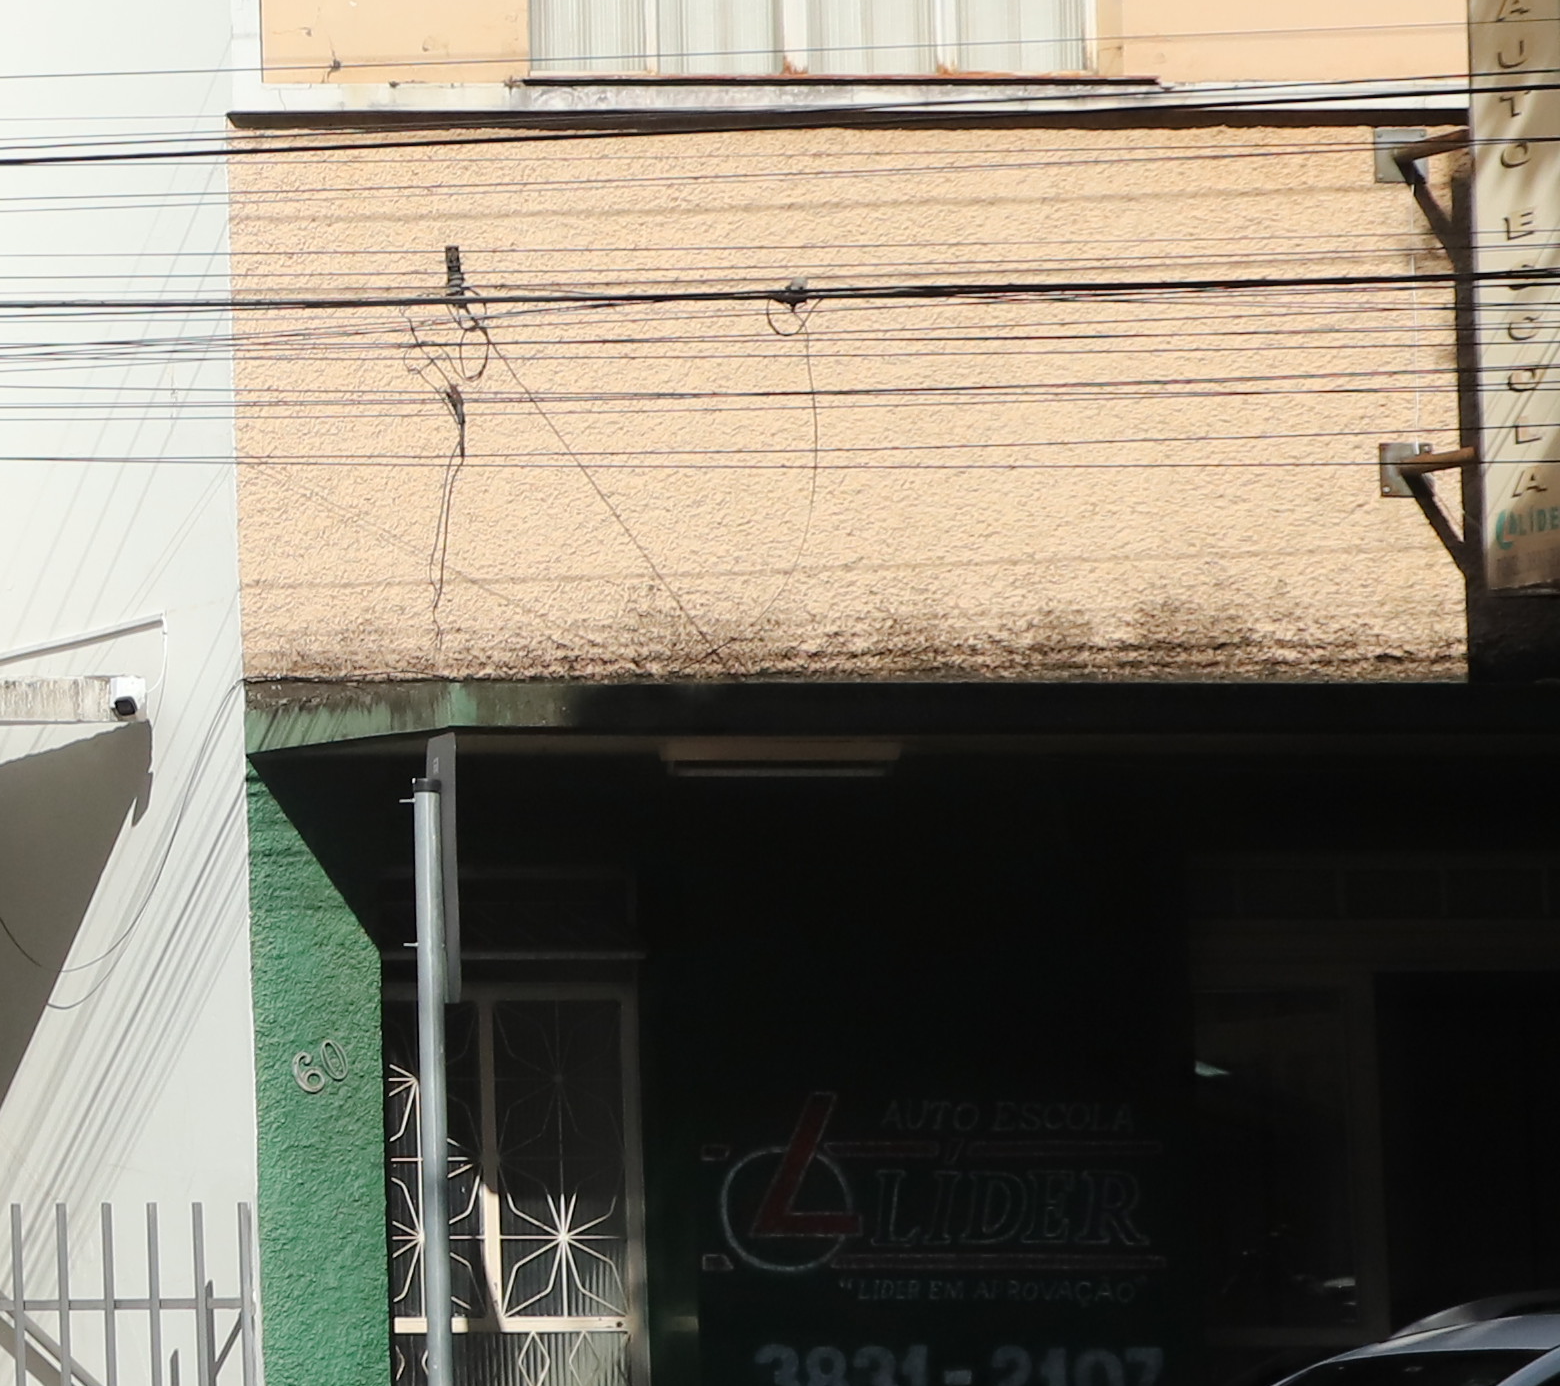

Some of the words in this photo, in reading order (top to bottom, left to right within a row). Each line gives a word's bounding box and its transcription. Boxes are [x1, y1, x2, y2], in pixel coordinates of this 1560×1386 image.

[292, 1040, 348, 1094] 60
[881, 1099, 978, 1132] AUTO
[991, 1100, 1135, 1133] ESCOLA
[870, 1137, 1151, 1247] LÍDER
[928, 1280, 965, 1301] EM
